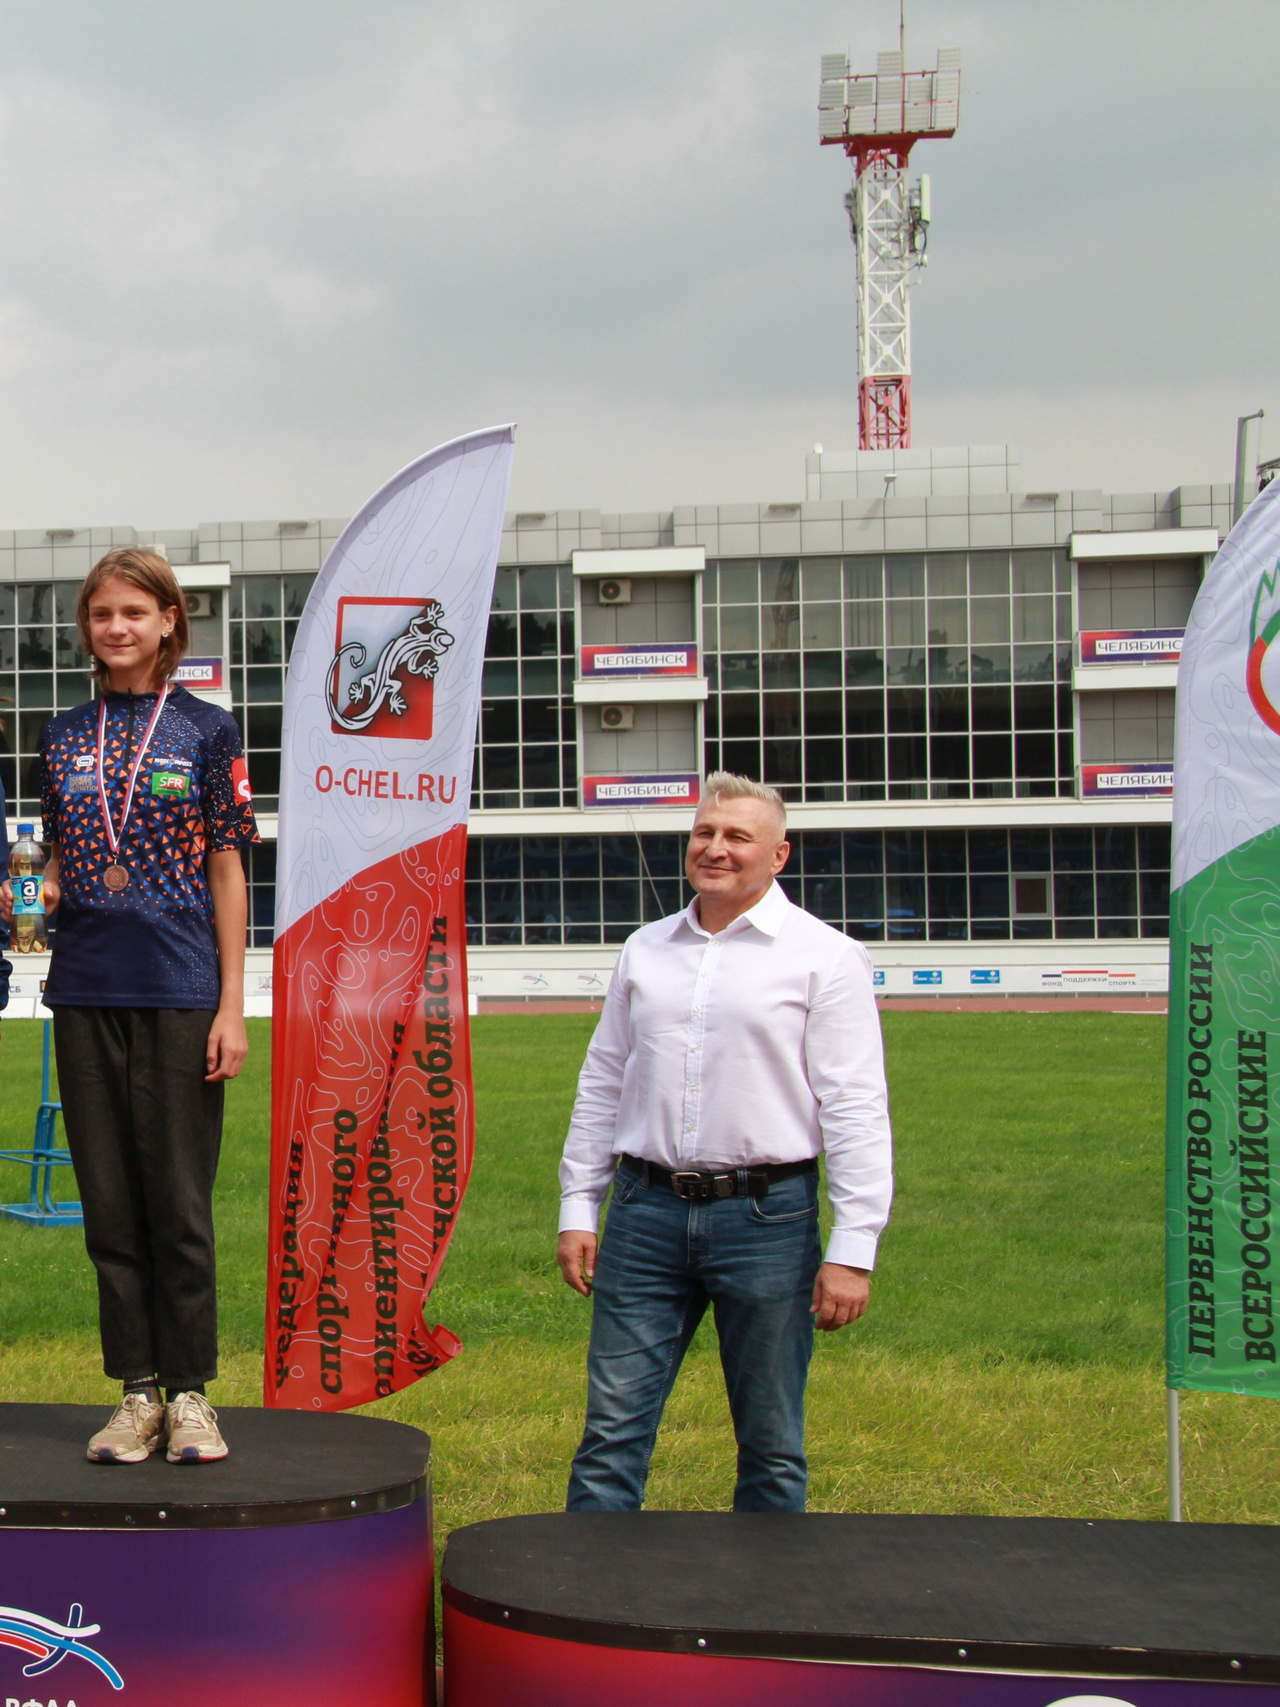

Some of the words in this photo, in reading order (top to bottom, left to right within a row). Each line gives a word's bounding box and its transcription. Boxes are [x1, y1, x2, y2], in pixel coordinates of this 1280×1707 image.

[1097, 640, 1183, 652] ЧЕЛЯБИНС
[596, 654, 685, 666] ЧЕЛЯБИНСК
[159, 776, 184, 789] SFR
[315, 765, 457, 804] O-CHEL.RU
[1099, 775, 1173, 786] ЧЕЛЯБИН
[598, 785, 687, 797] ЧЕЛЯБИНСК
[8, 985, 22, 994] СБ
[413, 915, 454, 1098] области
[1187, 943, 1214, 1102] РОССИИ
[1229, 1030, 1276, 1363] ВСЕРОССИЙСКИЕ
[1187, 1102, 1216, 1359] ПЕРВЕНСТВО
